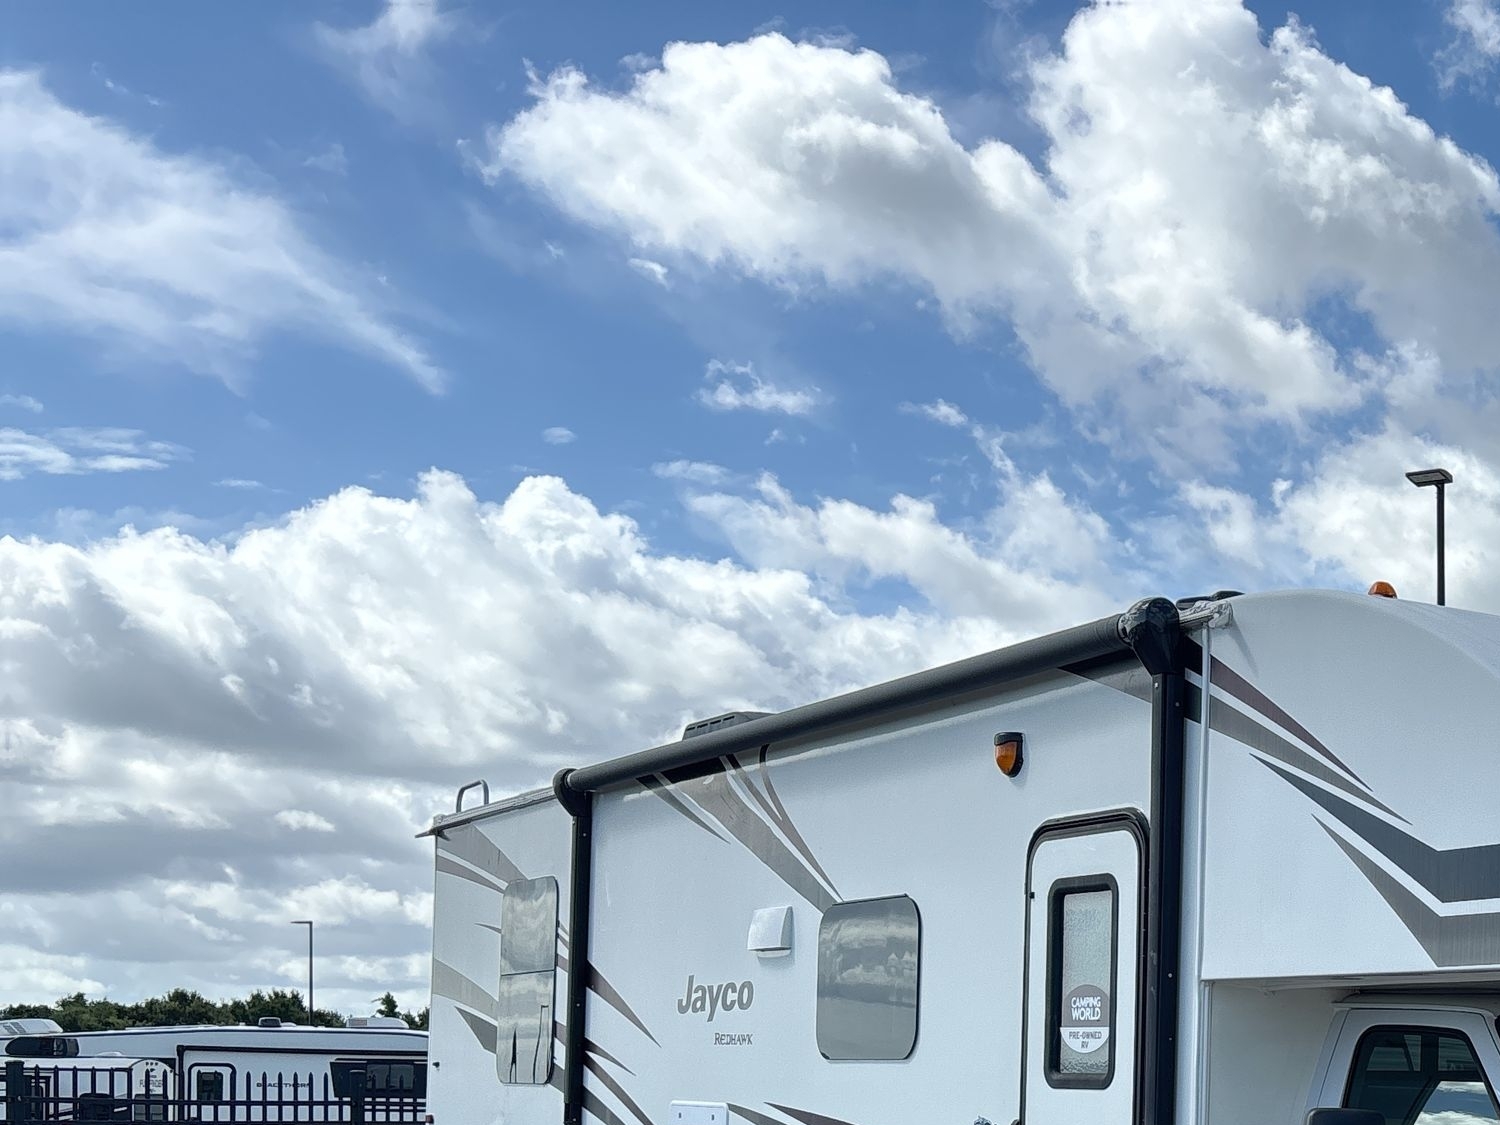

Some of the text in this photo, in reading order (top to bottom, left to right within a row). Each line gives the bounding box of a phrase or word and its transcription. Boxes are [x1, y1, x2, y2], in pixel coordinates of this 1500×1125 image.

[677, 974, 754, 1022] Jayco
[1071, 997, 1101, 1008] CAMPING
[1071, 1008, 1101, 1020] WORLD
[1069, 1031, 1102, 1039] PRE-OWNED
